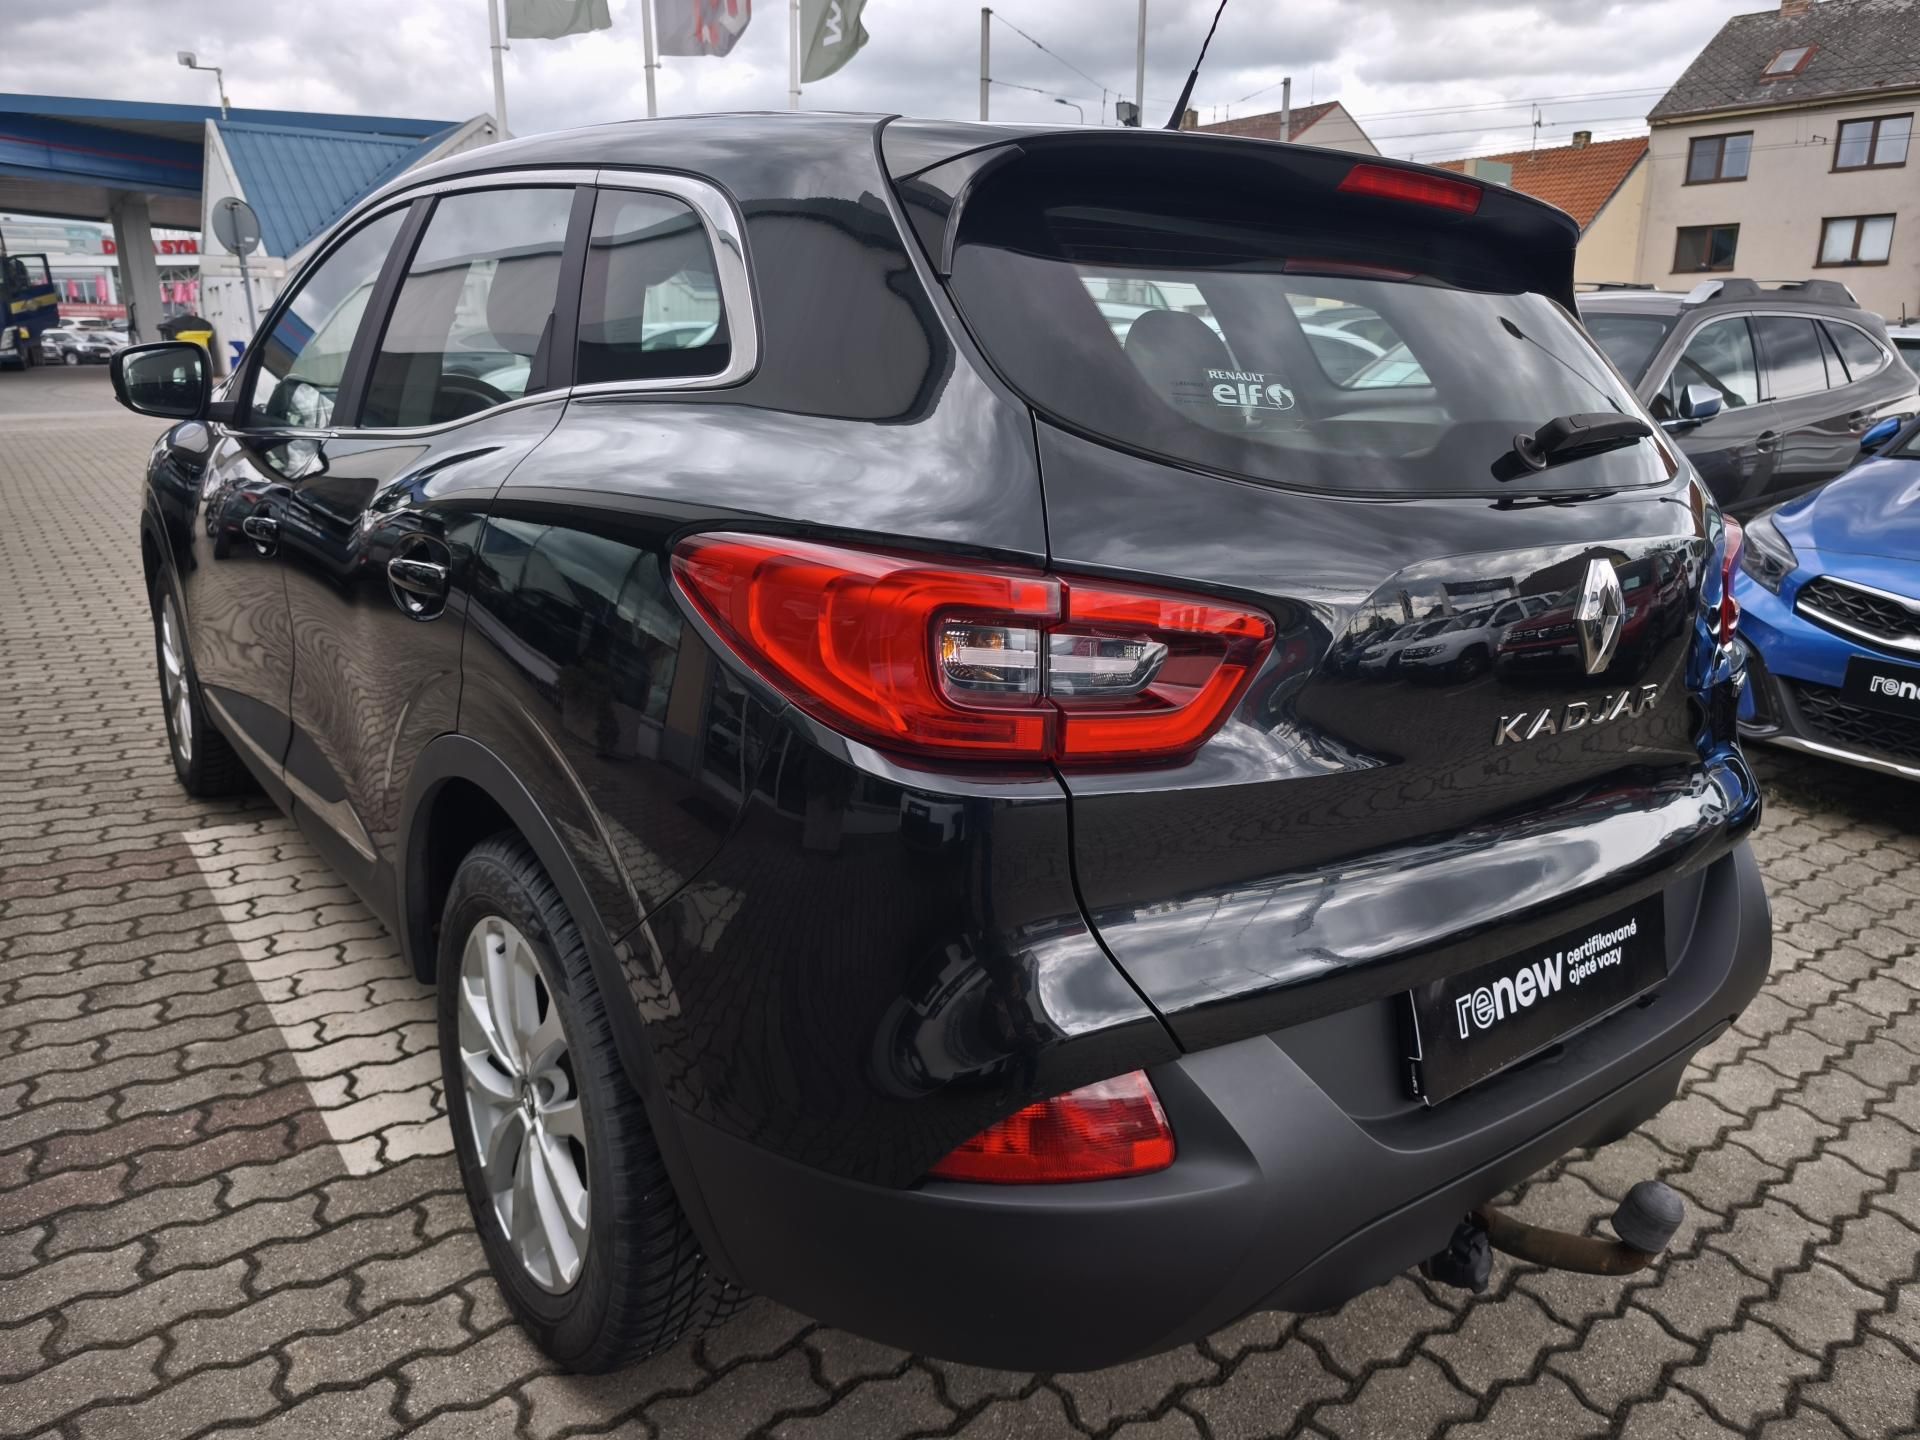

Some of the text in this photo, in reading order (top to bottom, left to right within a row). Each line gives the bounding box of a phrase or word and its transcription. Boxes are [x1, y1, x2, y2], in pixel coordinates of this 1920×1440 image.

[1208, 370, 1264, 383] RENAULT
[1212, 383, 1263, 405] elf
[1870, 675, 1920, 700] ren
[1494, 683, 1658, 746] KADJAR
[1567, 918, 1637, 965] certifikované
[1569, 946, 1622, 985] ojeté vozy
